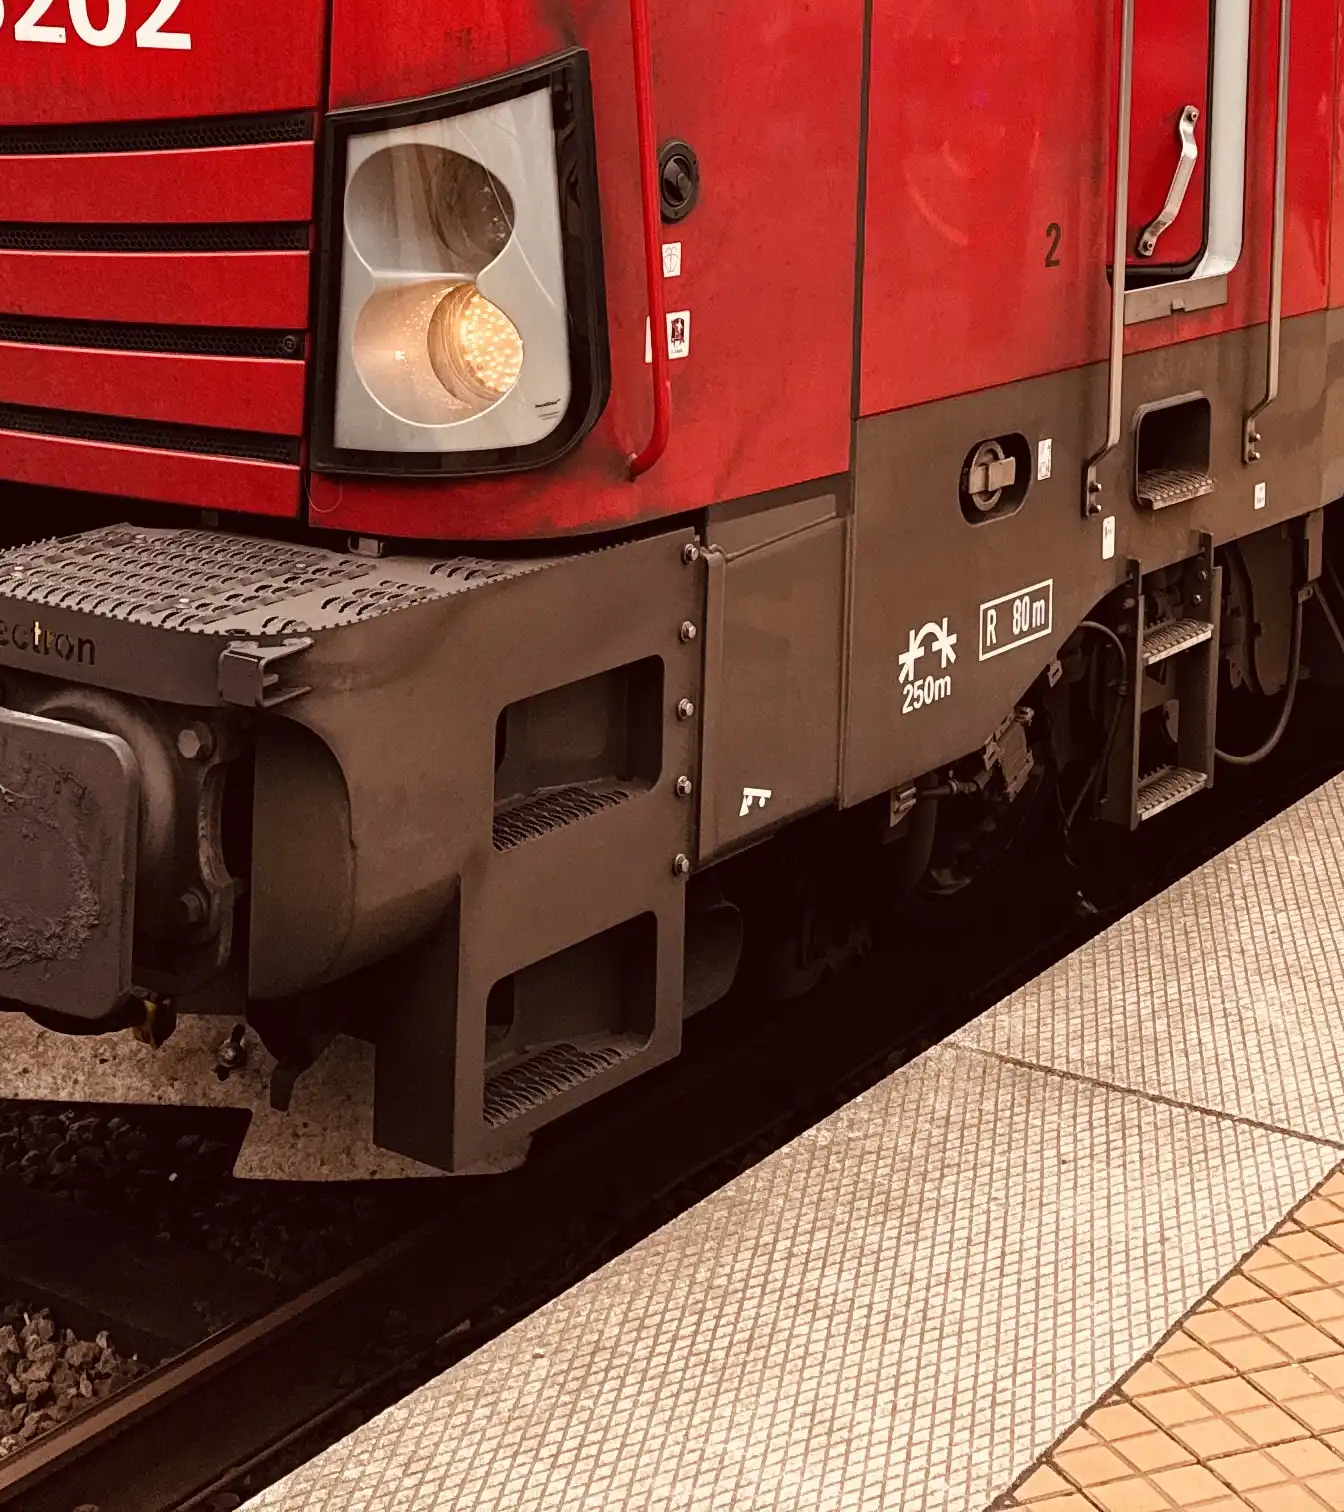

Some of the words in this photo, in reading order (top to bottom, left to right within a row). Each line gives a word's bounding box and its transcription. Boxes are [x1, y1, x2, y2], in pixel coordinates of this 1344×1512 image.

[1045, 222, 1061, 268] 2
[986, 608, 997, 647] R
[902, 675, 952, 715] 250m
